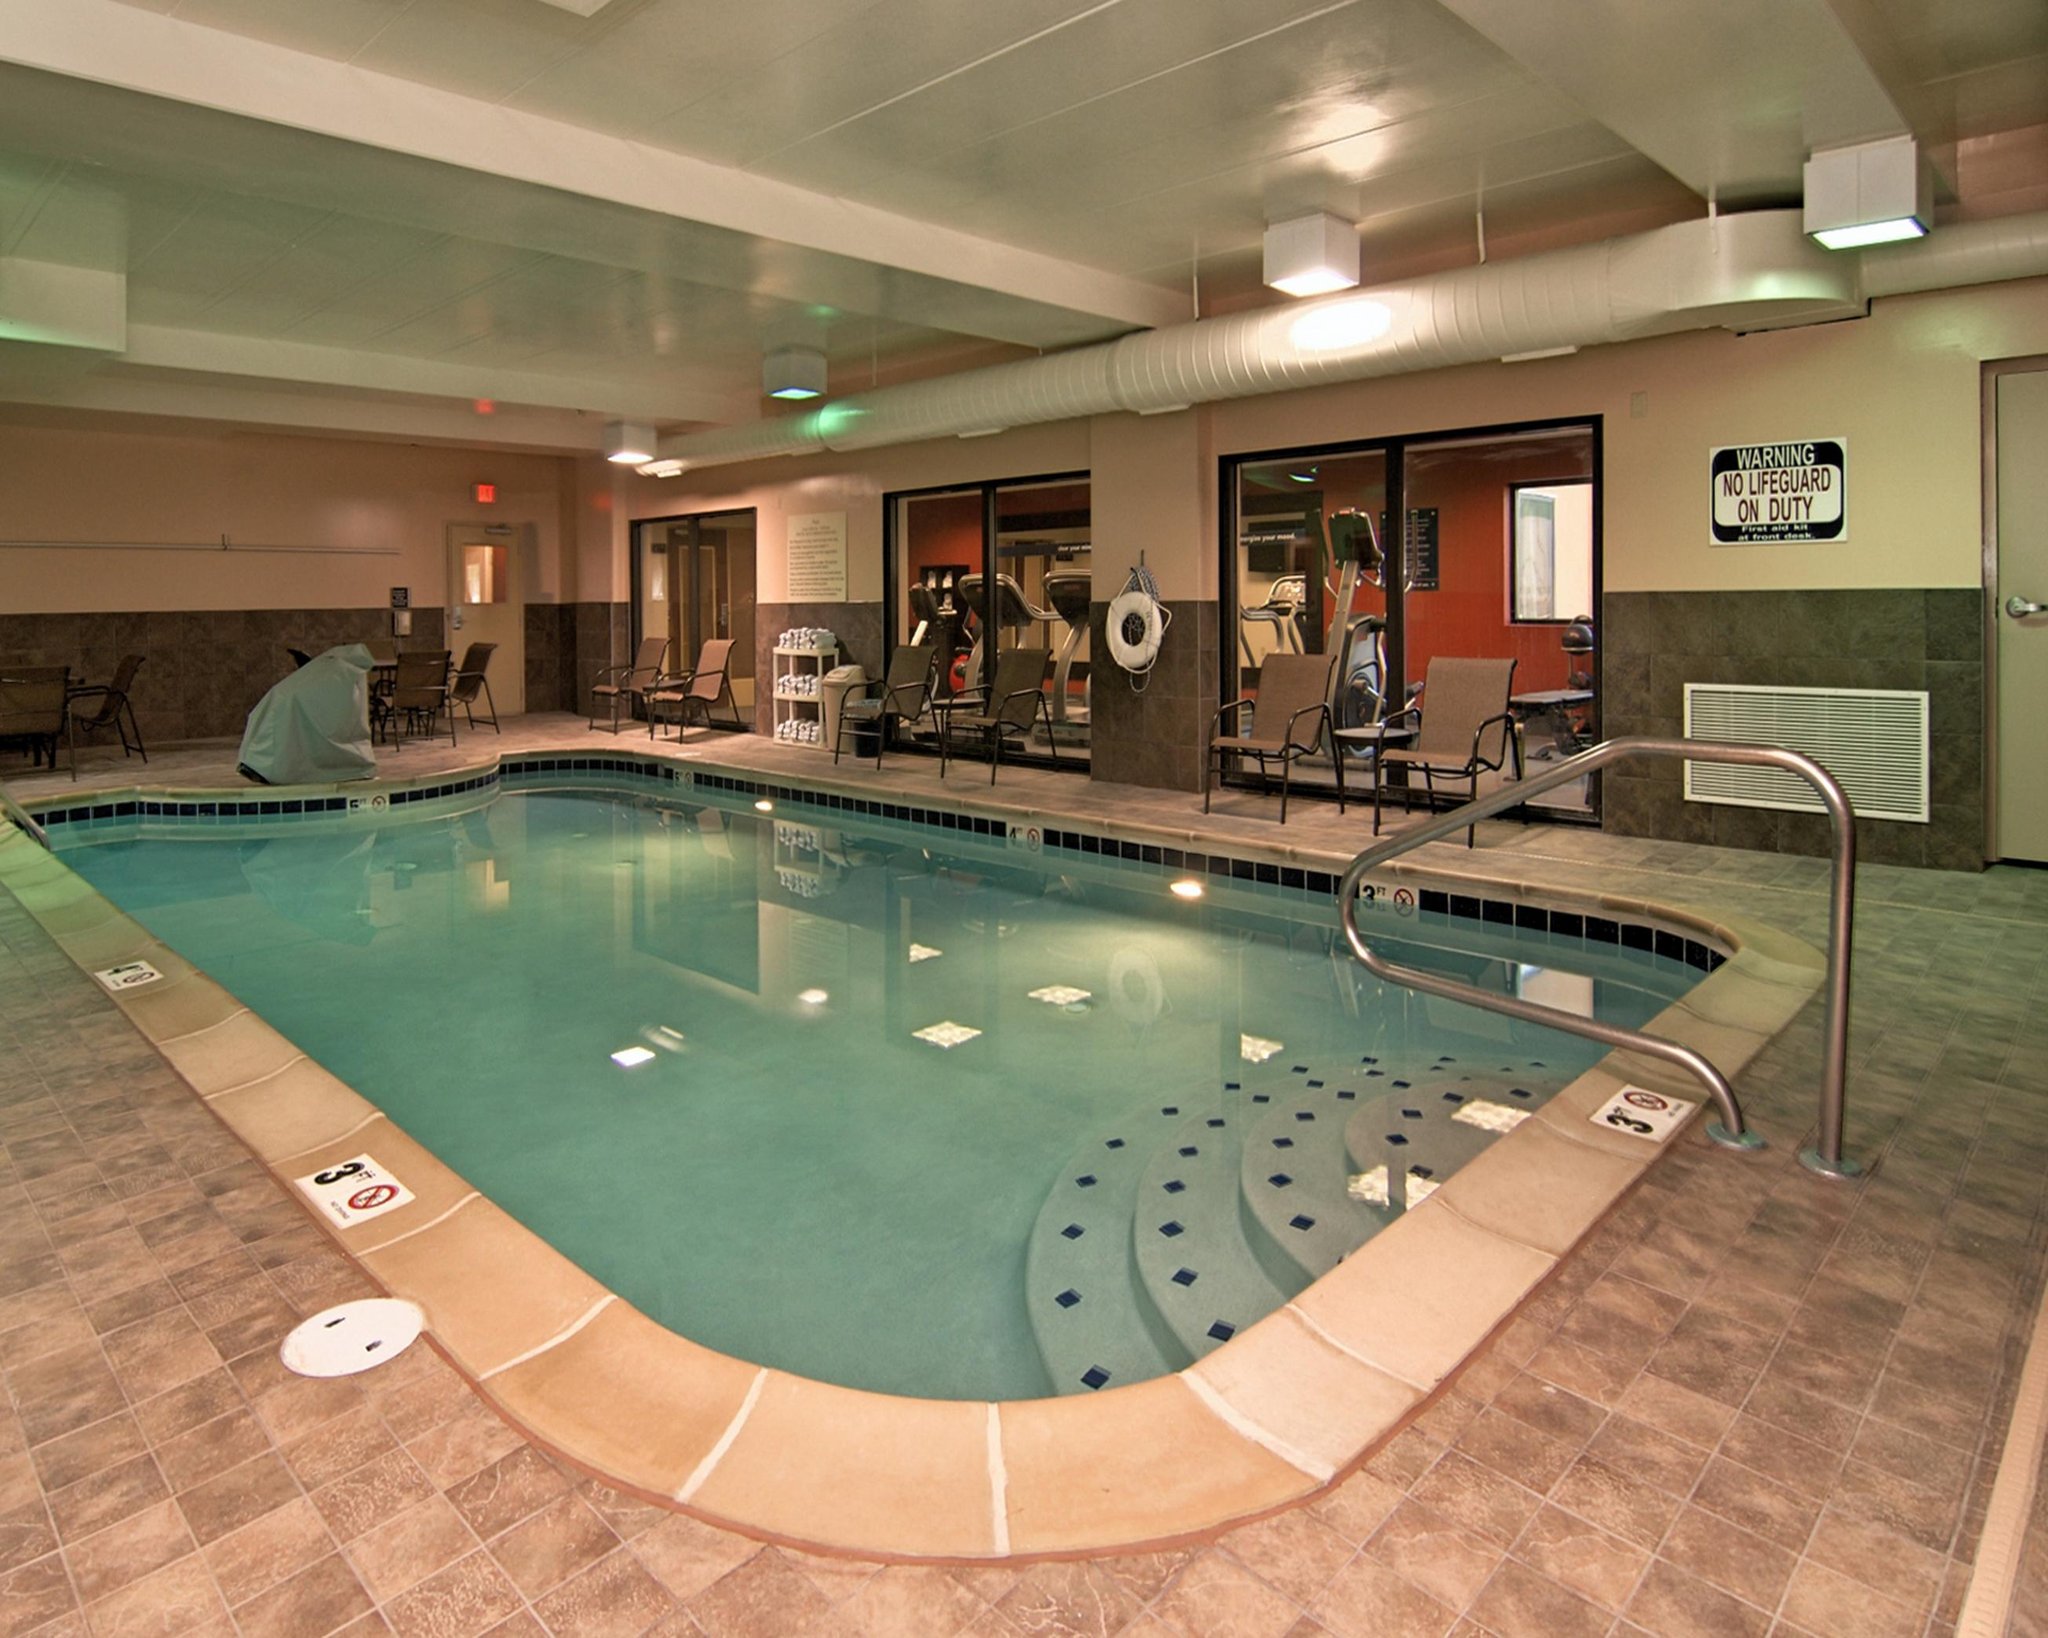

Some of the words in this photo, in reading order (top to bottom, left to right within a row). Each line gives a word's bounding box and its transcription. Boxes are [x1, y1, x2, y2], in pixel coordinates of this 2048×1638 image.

[1736, 443, 1815, 469] WARNING
[1723, 472, 1743, 497] NO
[1749, 467, 1831, 496] LIFEGUARD
[1738, 498, 1758, 523] ON
[1769, 496, 1813, 522] DUTY
[1738, 533, 1749, 541] at
[1752, 532, 1780, 541] front
[1741, 524, 1767, 533] First
[1771, 524, 1789, 532] aid
[1793, 523, 1808, 531] kit
[1606, 1113, 1653, 1133] 3
[314, 1162, 365, 1185] 3
